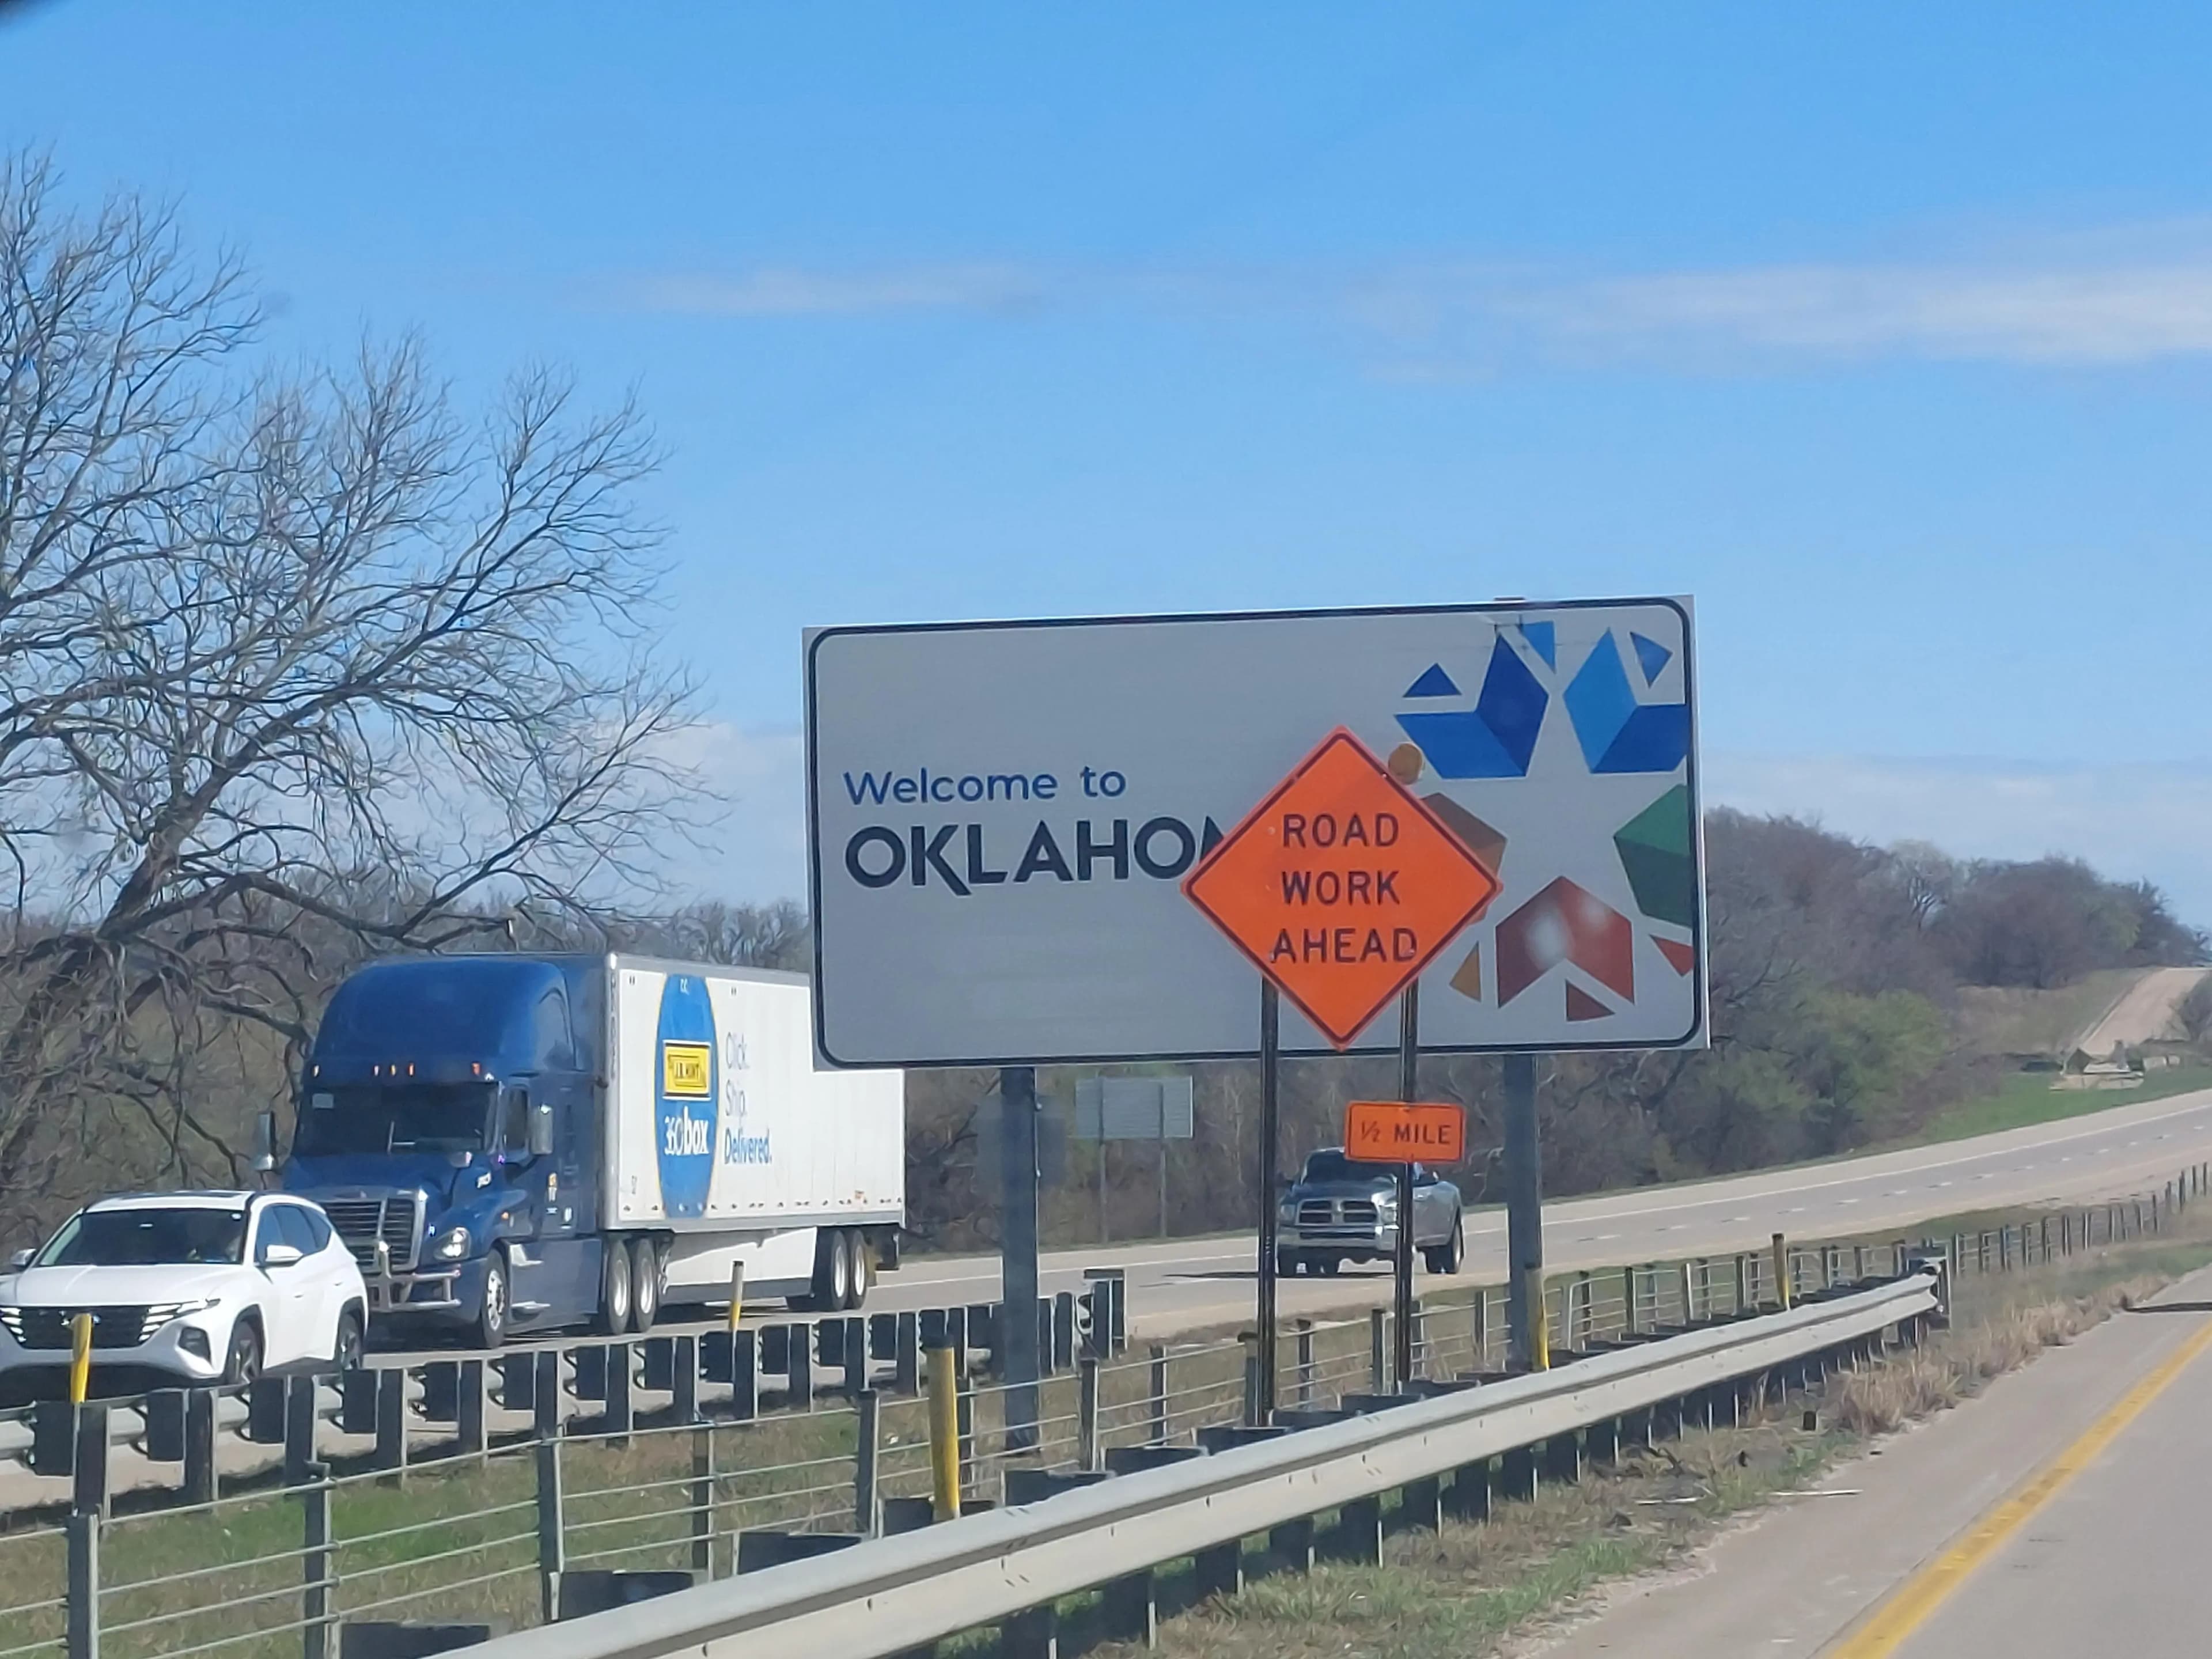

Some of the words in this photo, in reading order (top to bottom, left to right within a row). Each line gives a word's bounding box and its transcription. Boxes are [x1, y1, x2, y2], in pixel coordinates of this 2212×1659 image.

[844, 767, 1057, 805] Welcome
[1081, 766, 1126, 797] to
[1282, 813, 1399, 849] ROAD
[1281, 870, 1400, 906] WORK
[1270, 927, 1418, 964] AHEAD
[1394, 1123, 1451, 1144] MILE
